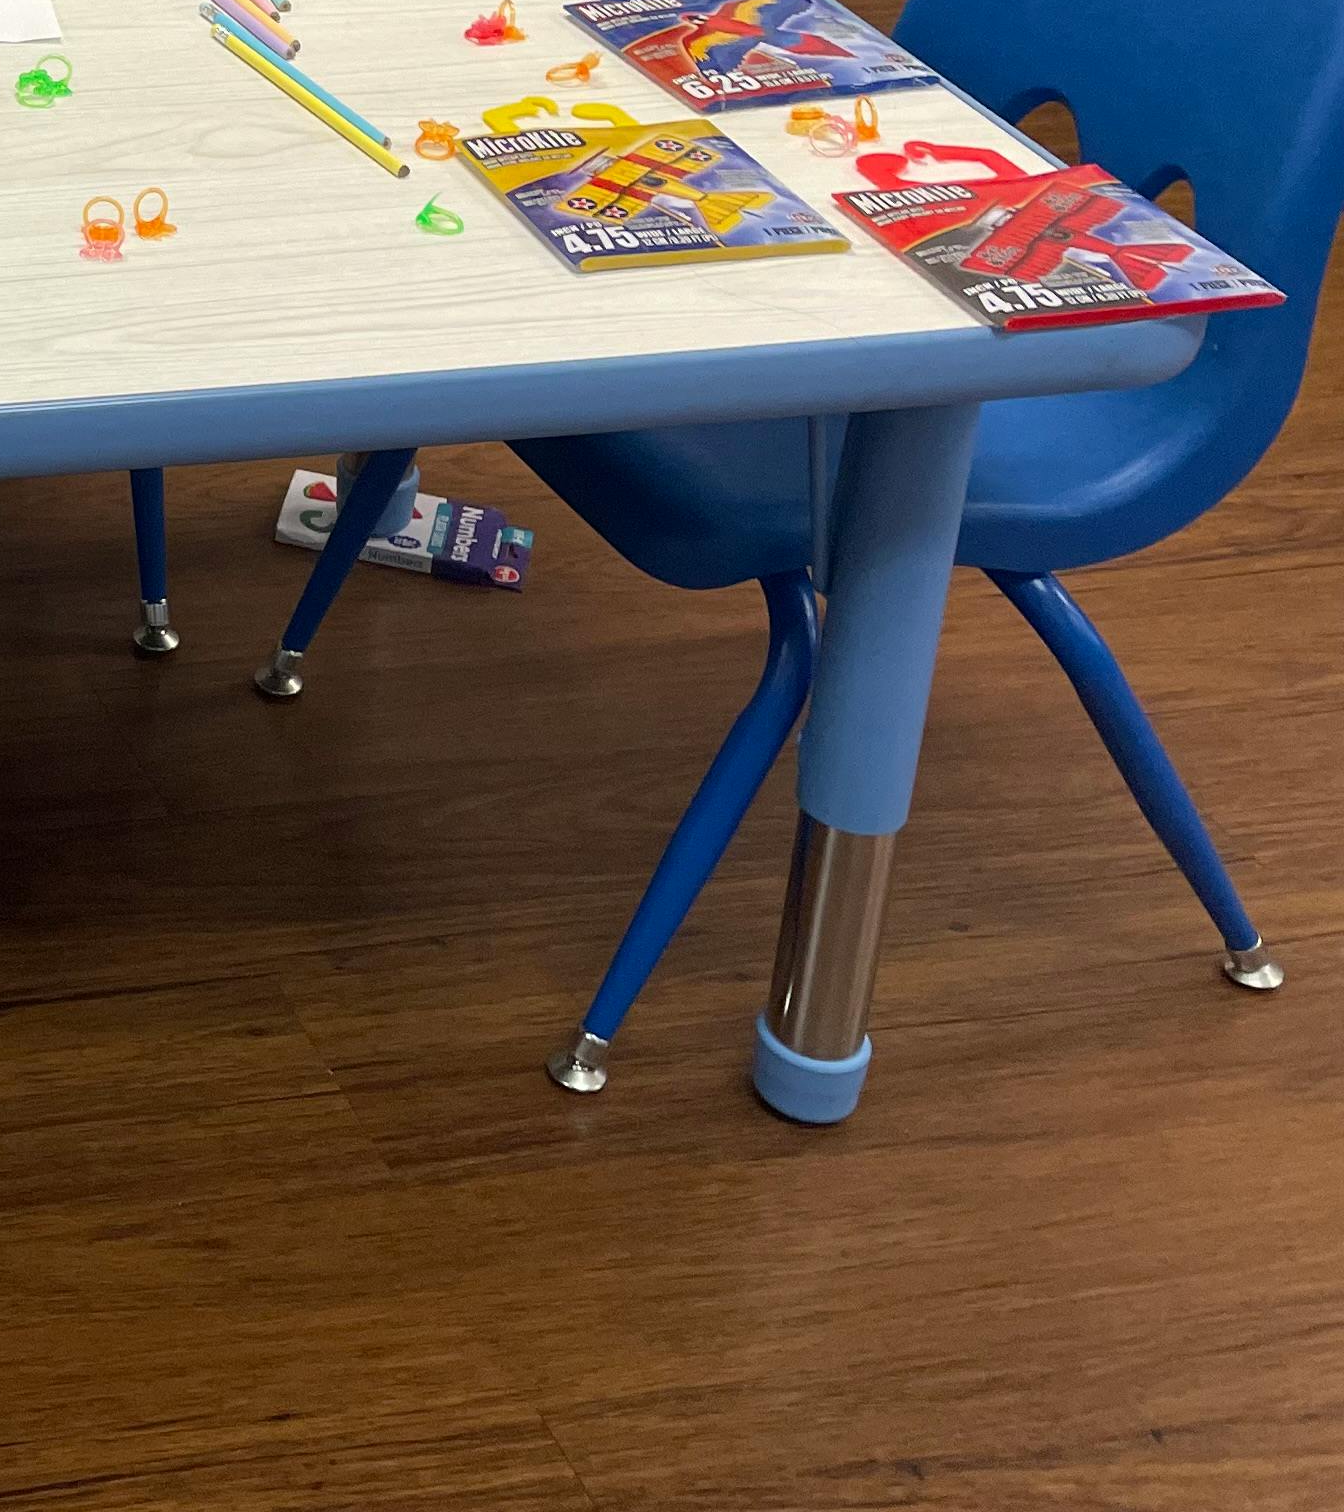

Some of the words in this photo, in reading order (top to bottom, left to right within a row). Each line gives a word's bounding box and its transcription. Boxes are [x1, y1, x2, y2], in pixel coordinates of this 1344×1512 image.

[682, 70, 762, 100] 6.25
[466, 130, 583, 160] MicroKite
[849, 185, 976, 216] MicroKite
[564, 225, 640, 255] 4.75
[980, 281, 1066, 317] 4.75
[450, 505, 485, 563] Numbers
